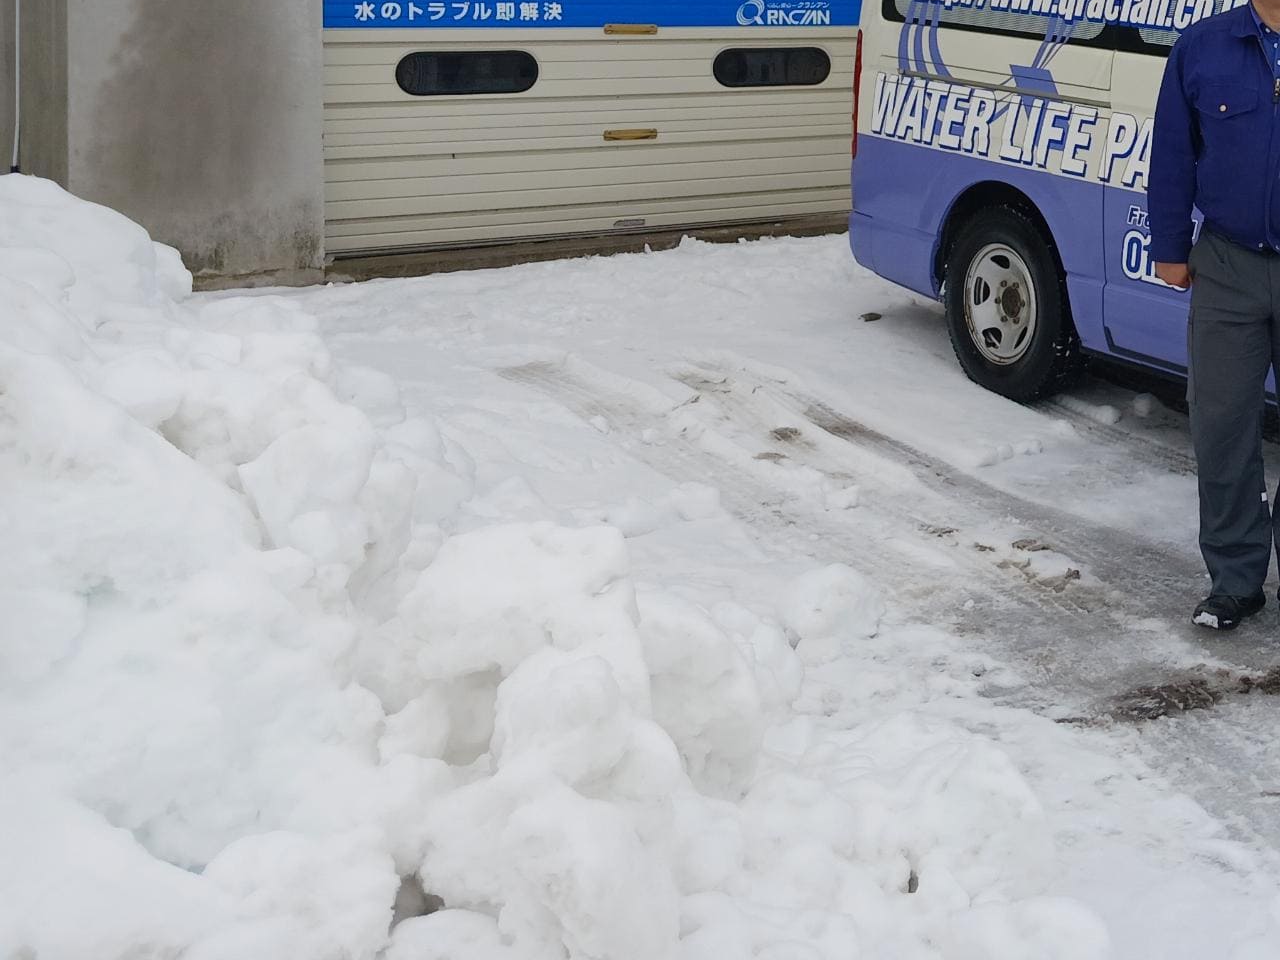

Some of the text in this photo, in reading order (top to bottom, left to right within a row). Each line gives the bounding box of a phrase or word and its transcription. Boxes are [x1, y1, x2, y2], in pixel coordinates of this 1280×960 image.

[354, 1, 563, 21] 水のトラブル即解決
[871, 72, 997, 157] WATER
[999, 92, 1098, 177] LIFE
